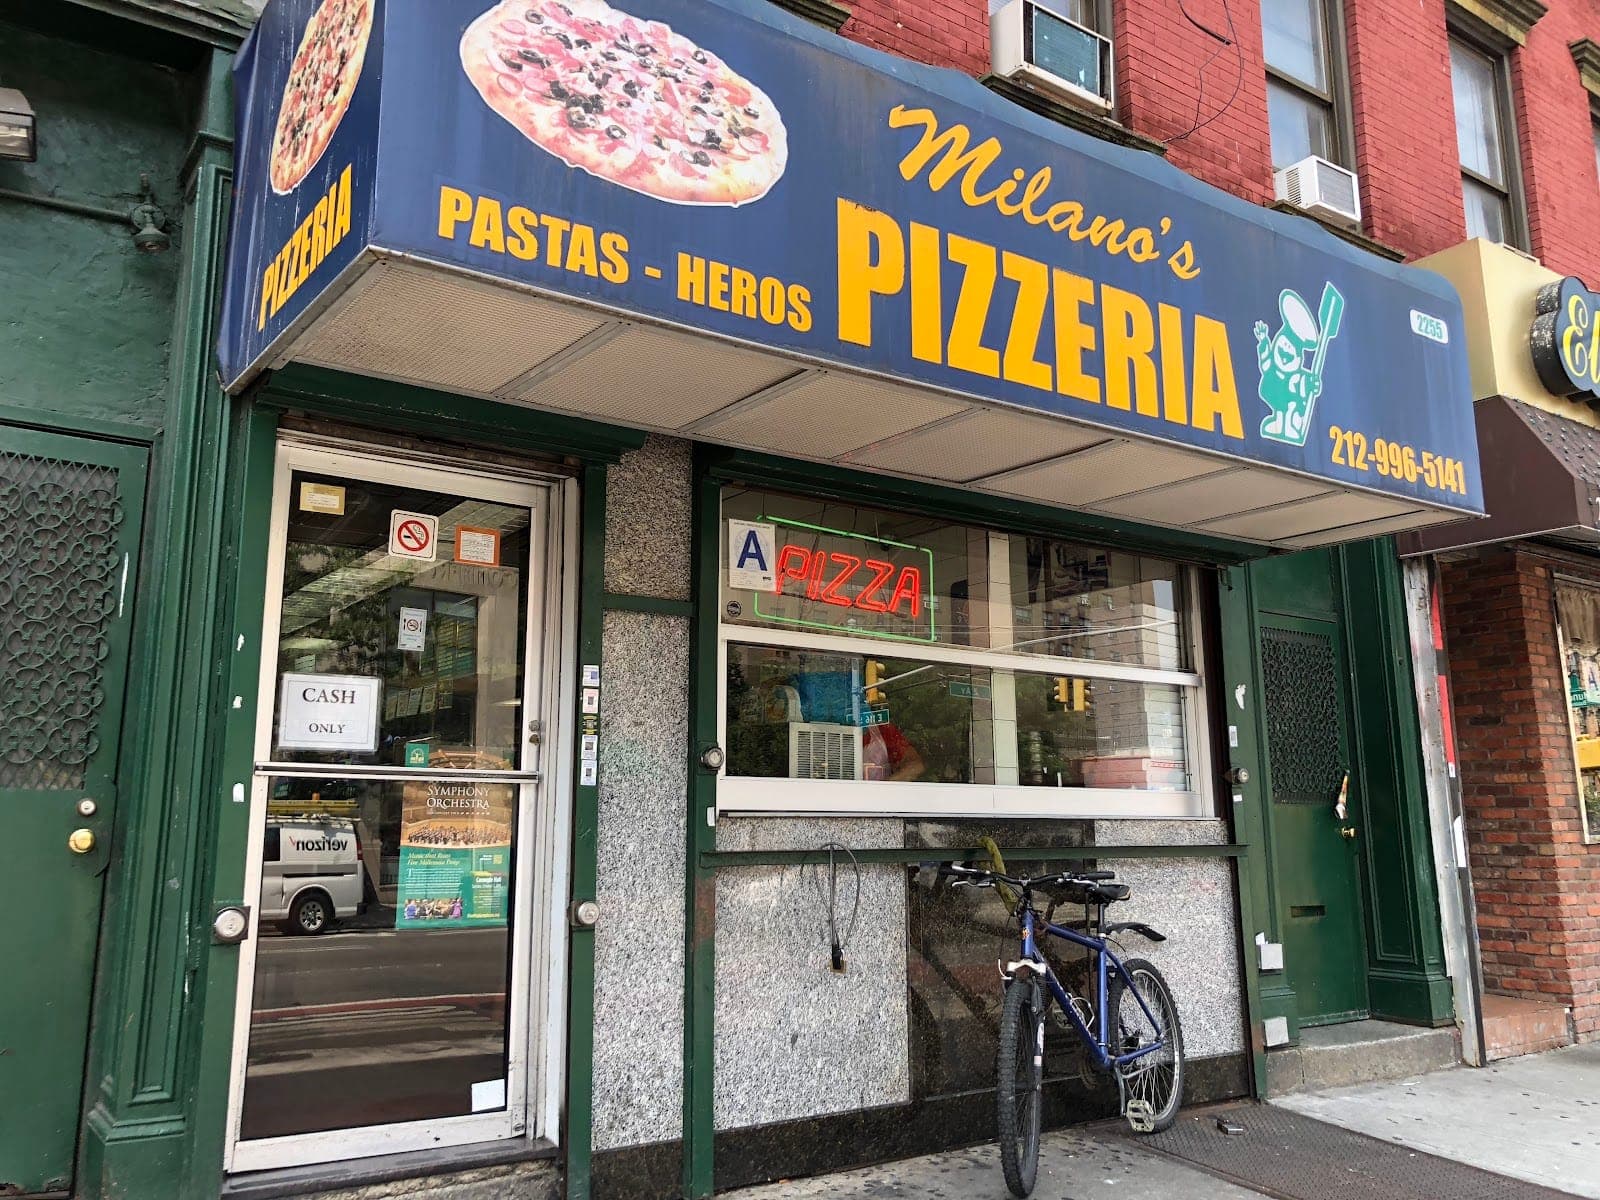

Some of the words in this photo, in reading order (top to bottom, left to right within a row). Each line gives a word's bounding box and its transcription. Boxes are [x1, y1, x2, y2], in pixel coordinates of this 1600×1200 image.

[889, 104, 1200, 279] Milano's
[258, 163, 352, 332] PIZZERIA
[438, 185, 629, 284] PASTAS
[677, 251, 813, 332] HEROS
[837, 197, 1244, 439] PIZZERIA
[1416, 313, 1444, 340] 2255
[1329, 425, 1467, 495] 212-996-5141
[736, 530, 768, 571] A
[776, 544, 920, 618] PIZZA
[302, 687, 356, 704] CASH
[308, 722, 346, 734] ONLY
[426, 785, 490, 797] SYMPHONY
[426, 797, 490, 810] ORCHESTRA
